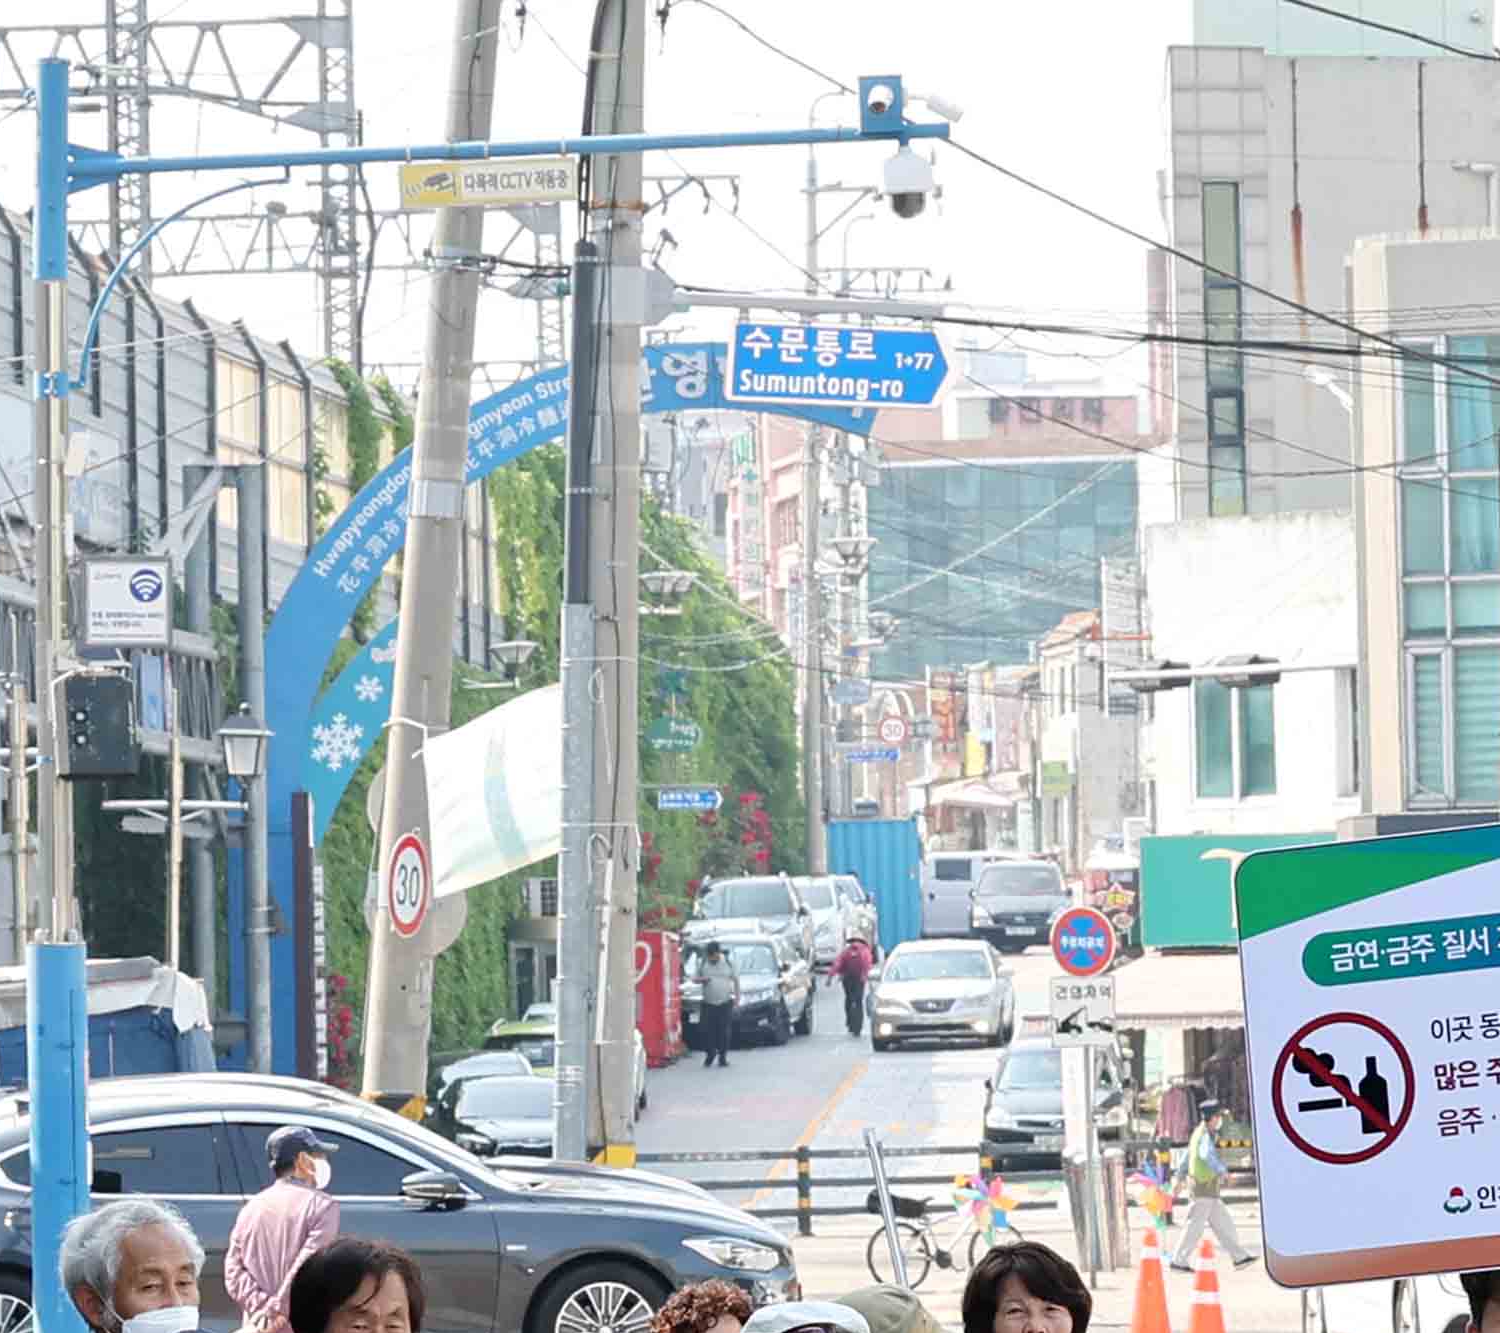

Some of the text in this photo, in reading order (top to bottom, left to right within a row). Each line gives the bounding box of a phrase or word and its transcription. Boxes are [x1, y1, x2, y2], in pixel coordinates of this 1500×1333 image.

[500, 171, 534, 189] CCTV
[742, 324, 877, 367] 수문통로
[739, 368, 905, 400] Sumuntong-ro
[312, 464, 413, 578] Hwapyeongdon
[396, 862, 421, 908] 30
[1329, 932, 1437, 974] 금연·금주
[1442, 926, 1491, 962] 질서
[1430, 1013, 1474, 1044] 이곳
[1433, 1057, 1481, 1092] 많은
[1436, 1108, 1485, 1137] 음주
